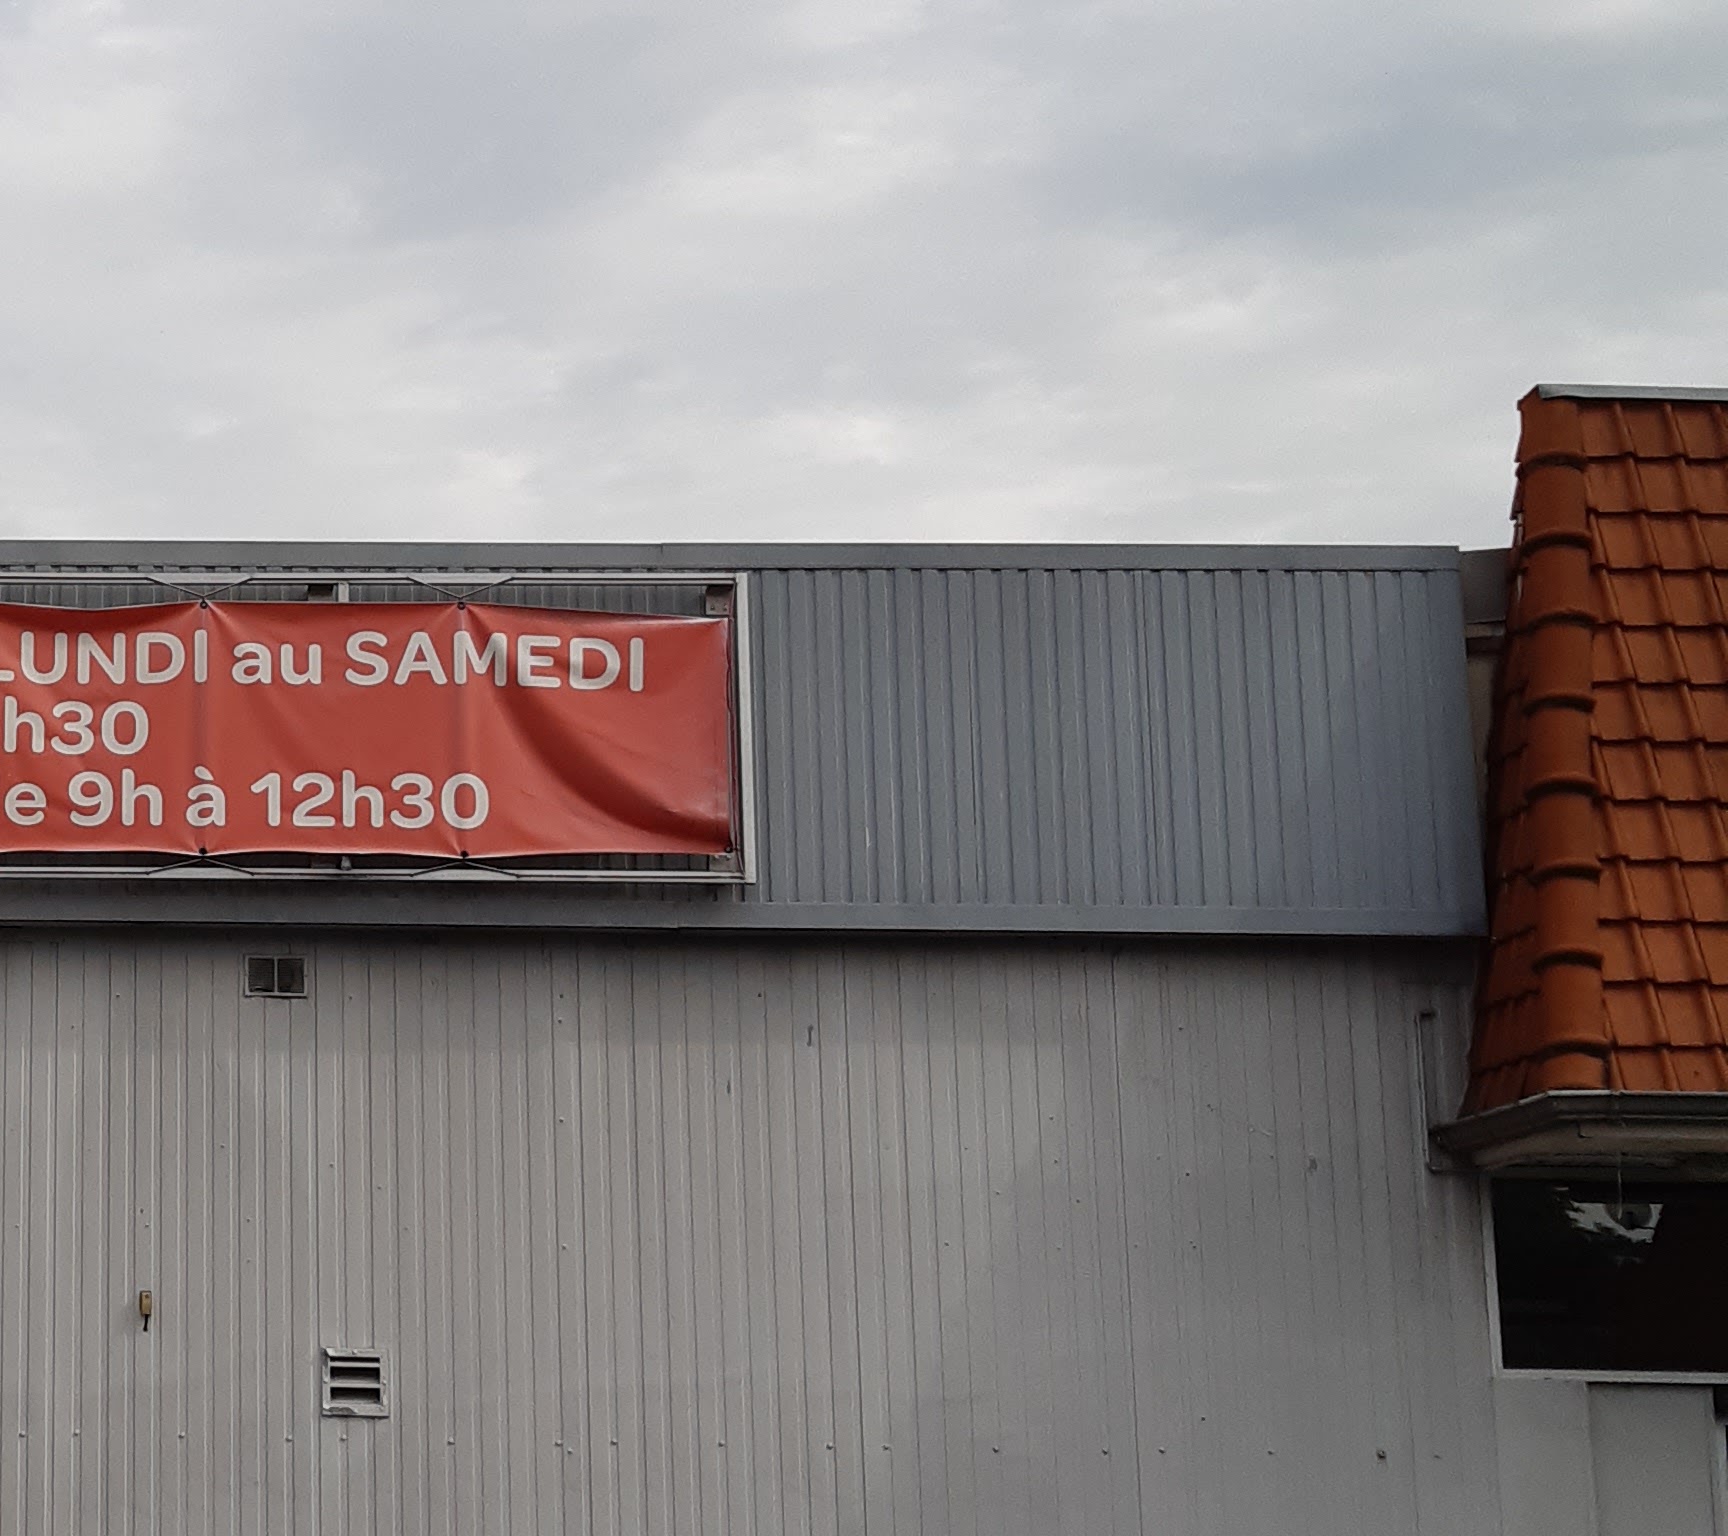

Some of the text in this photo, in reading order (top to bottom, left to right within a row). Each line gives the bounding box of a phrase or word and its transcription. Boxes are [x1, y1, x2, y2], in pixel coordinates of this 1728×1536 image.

[231, 642, 323, 686] au
[345, 629, 646, 692] SAMEDI
[67, 768, 163, 827] 9h
[186, 766, 226, 827] à
[250, 768, 490, 829] 12h30
